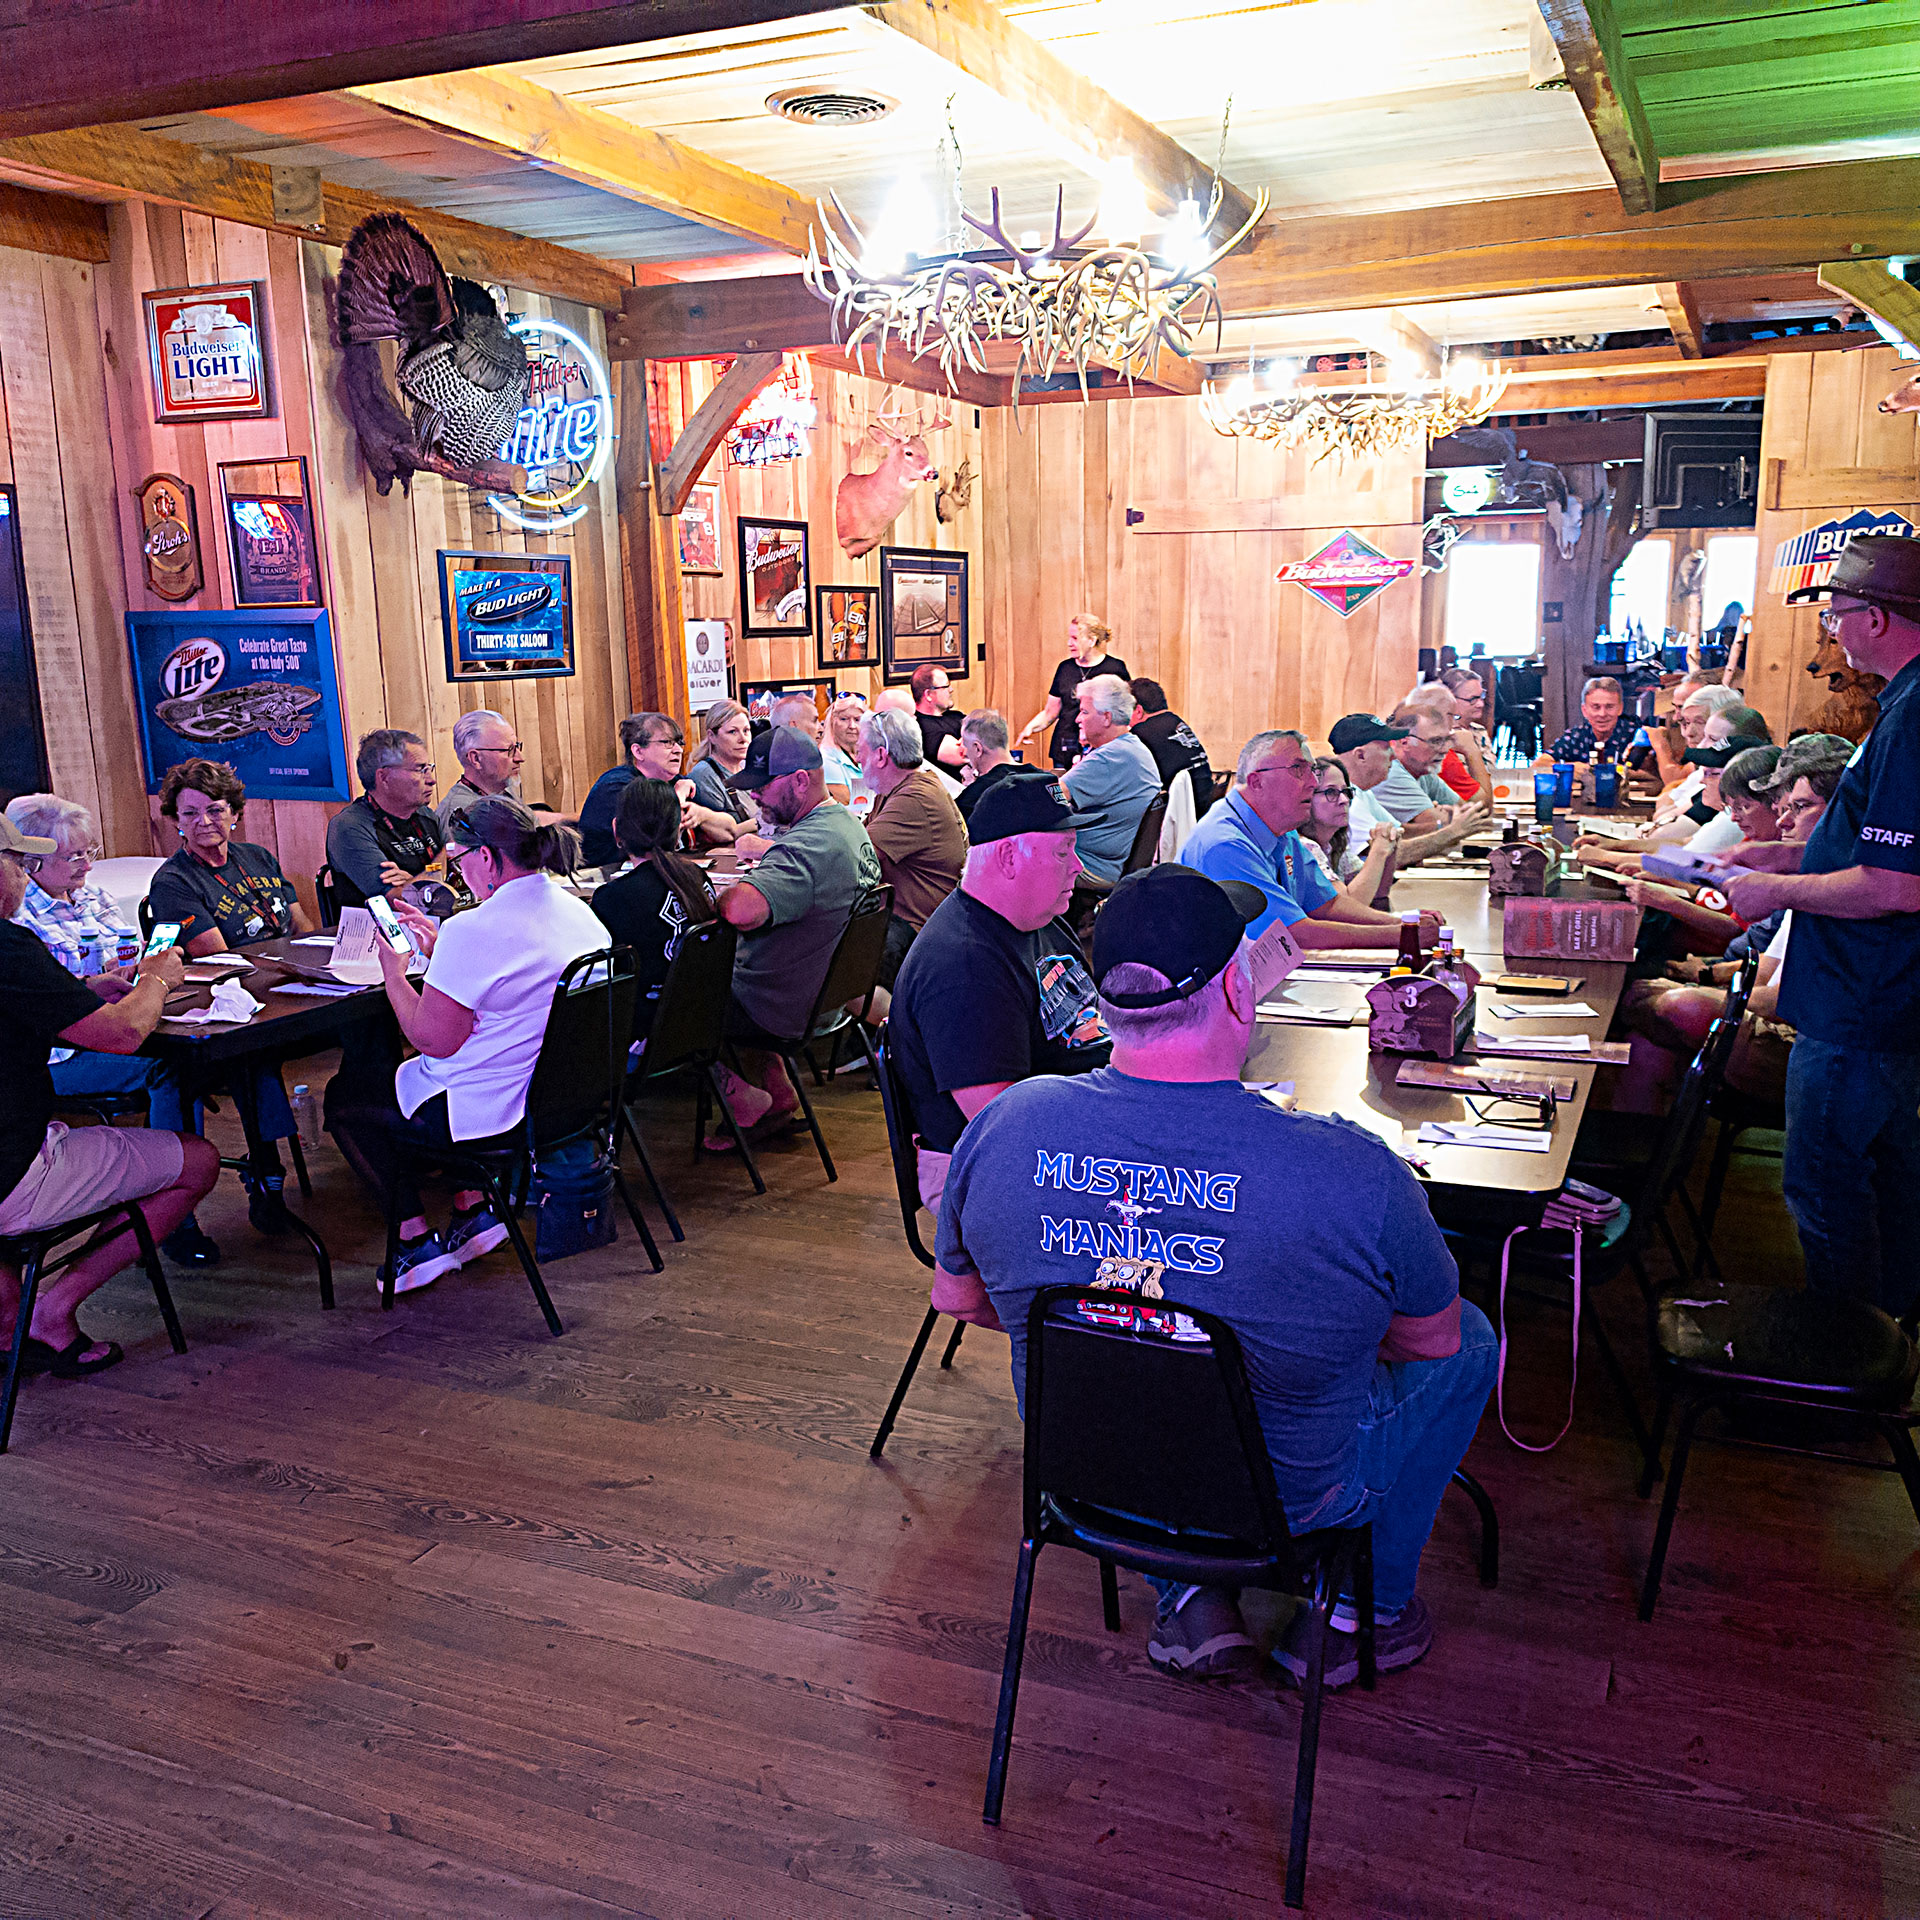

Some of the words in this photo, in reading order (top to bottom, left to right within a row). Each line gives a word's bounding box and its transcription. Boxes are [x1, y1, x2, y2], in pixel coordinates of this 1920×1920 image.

[171, 340, 241, 356] Budweiser
[174, 355, 242, 379] LIGHT
[503, 396, 601, 464] ite
[152, 530, 190, 555] Stroh's
[261, 539, 281, 554] E&J
[745, 543, 801, 573] Budweiser
[260, 565, 288, 576] BRANDY
[1282, 563, 1408, 581] Budweiser
[459, 583, 484, 597] MAKE
[485, 580, 494, 590] IT
[494, 579, 501, 588] A
[475, 598, 506, 617] BUD
[507, 586, 546, 608] LIGHT
[548, 597, 559, 608] AT
[239, 638, 270, 653] Celebrate
[270, 638, 289, 653] Great
[288, 637, 308, 653] Taste
[520, 633, 548, 648] SALOON
[174, 646, 209, 666] Miller
[251, 657, 259, 670] at
[259, 655, 270, 670] the
[270, 655, 285, 673] Indy
[285, 655, 300, 670] 500
[174, 656, 220, 699] Lite
[1861, 826, 1915, 848] STAFF
[1511, 850, 1522, 865] 2
[214, 894, 236, 920] THE
[236, 876, 281, 896] AERN
[424, 887, 432, 903] 6
[1404, 986, 1418, 1008] 3
[1034, 1149, 1242, 1213] MUSTANG
[1040, 1215, 1226, 1275] MANIACS
